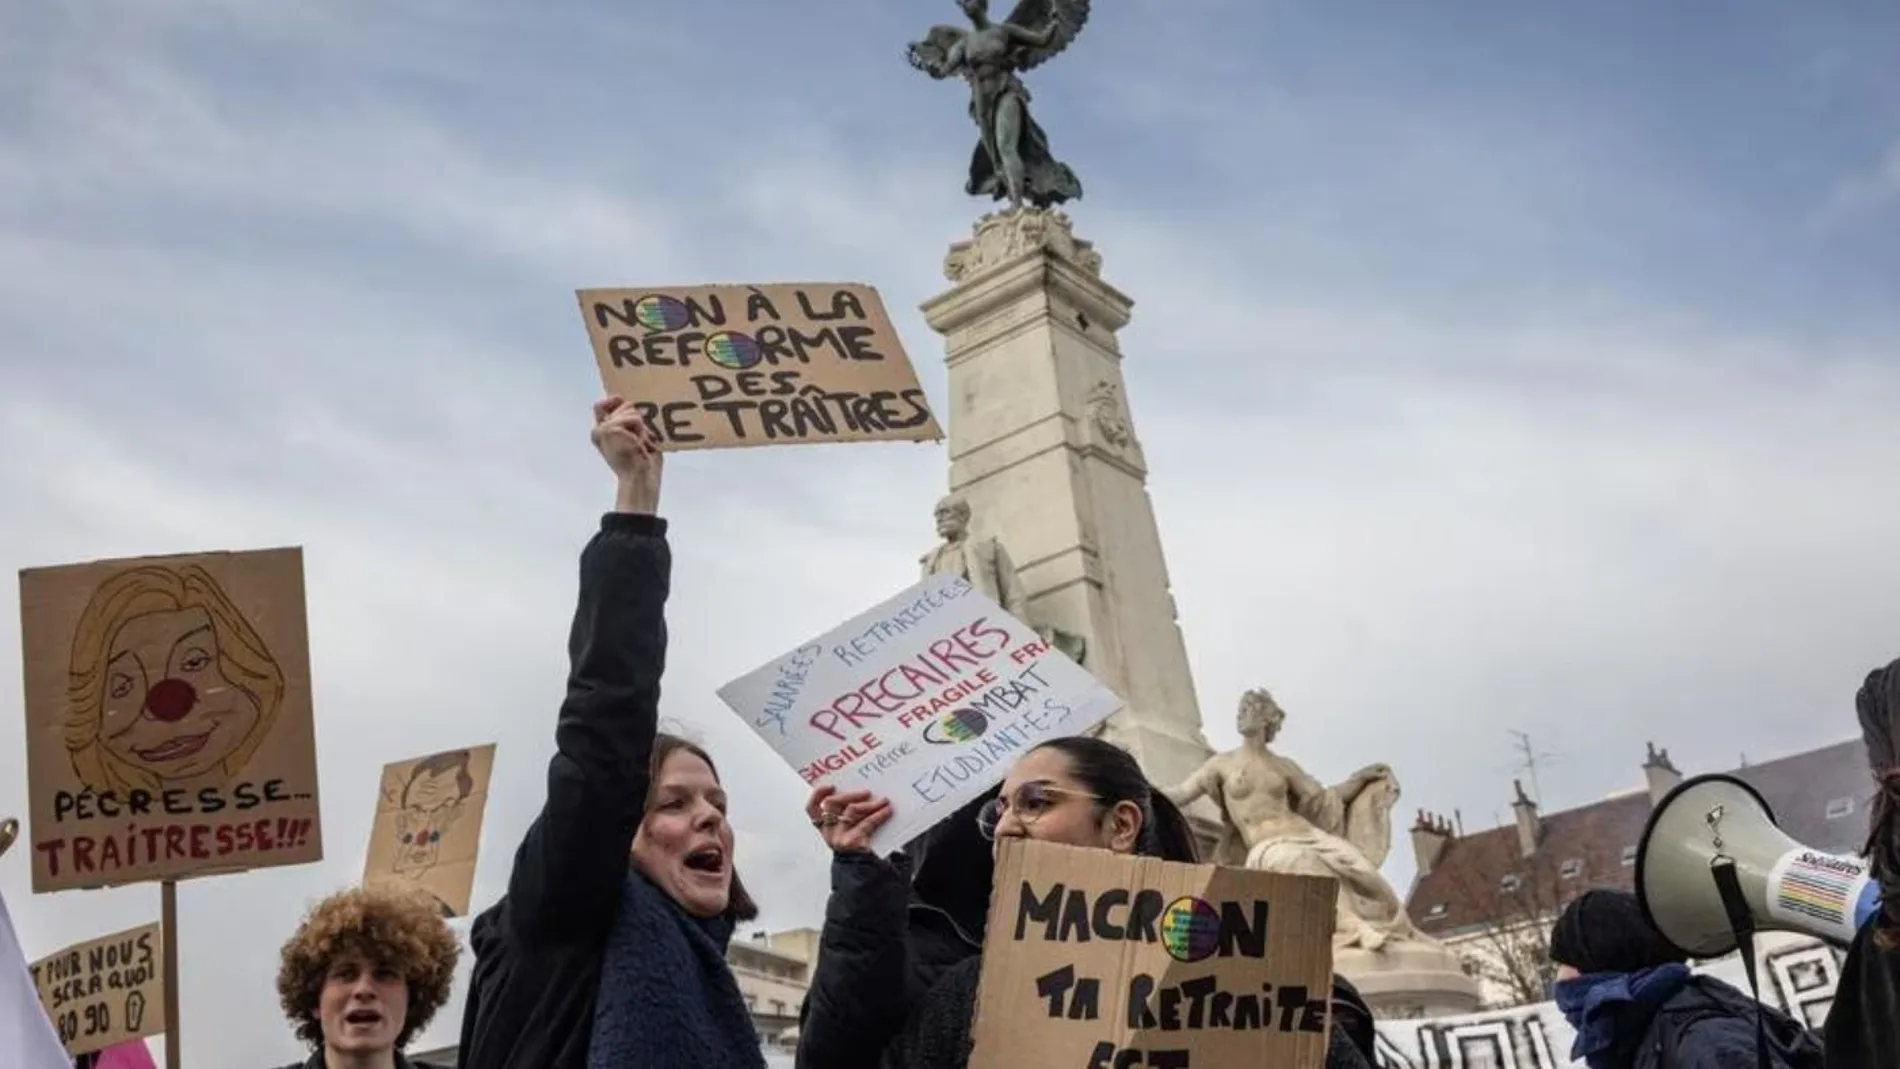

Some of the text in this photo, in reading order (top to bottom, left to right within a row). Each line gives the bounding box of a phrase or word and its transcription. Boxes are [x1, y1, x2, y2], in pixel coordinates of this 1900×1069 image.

[594, 294, 727, 332] NON
[746, 285, 780, 321] À
[794, 290, 866, 320] LA
[689, 371, 801, 400] DES
[808, 616, 1011, 742] PRECAIRES
[898, 668, 999, 730] FRAGILE
[922, 661, 1050, 745] COMBAT
[1014, 880, 1269, 963] MACRON
[46, 951, 82, 984] POUR
[89, 932, 152, 974] NOUS
[84, 1001, 110, 1036] 90
[1036, 964, 1100, 1020] TA
